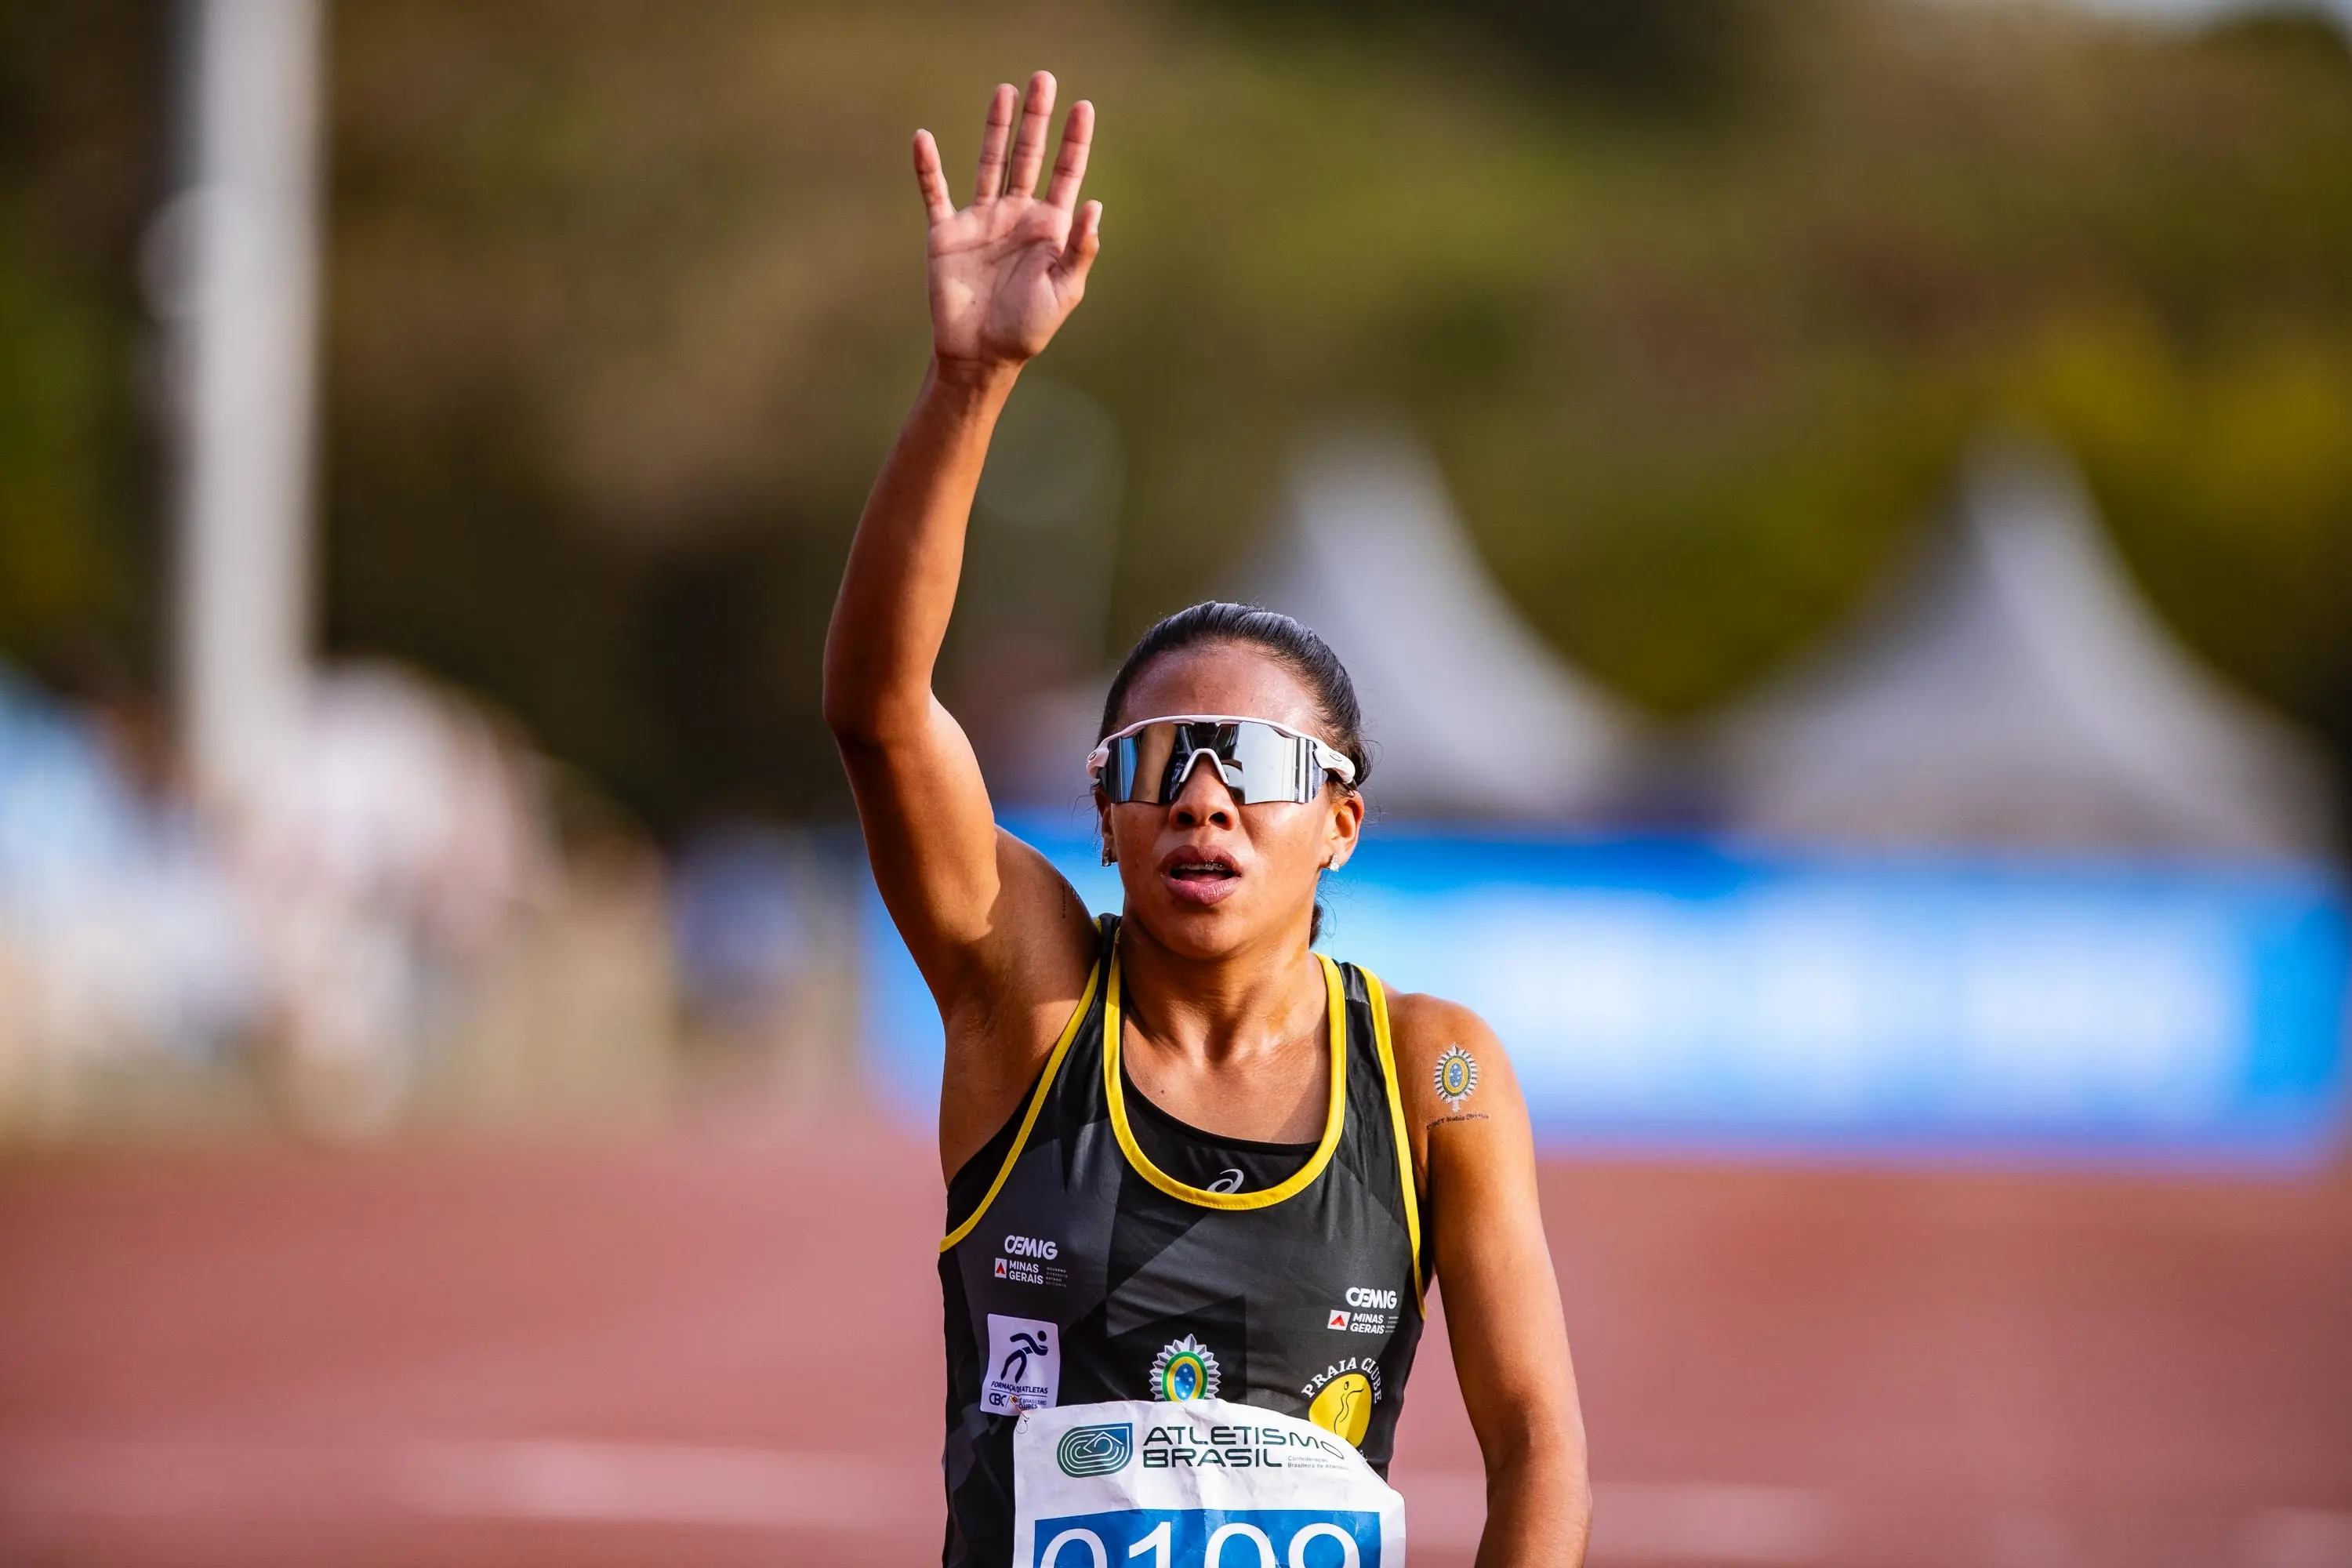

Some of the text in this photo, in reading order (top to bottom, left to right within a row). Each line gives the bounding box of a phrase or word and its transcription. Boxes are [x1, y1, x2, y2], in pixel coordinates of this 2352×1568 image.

[1004, 1235, 1058, 1260] CEMIG
[1009, 1260, 1039, 1273] MINAS
[1009, 1271, 1044, 1284] GERAIS
[1345, 1287, 1398, 1309] CEMIG
[1352, 1312, 1384, 1324] MINAS
[1350, 1323, 1385, 1334] GERAIS
[1301, 1357, 1382, 1404] PRAIA CLUBE
[1022, 1385, 1048, 1394] ATLETAS
[989, 1392, 1007, 1406] CBC
[1143, 1426, 1345, 1460] ATLETISMO
[1143, 1448, 1282, 1468] BRASIL
